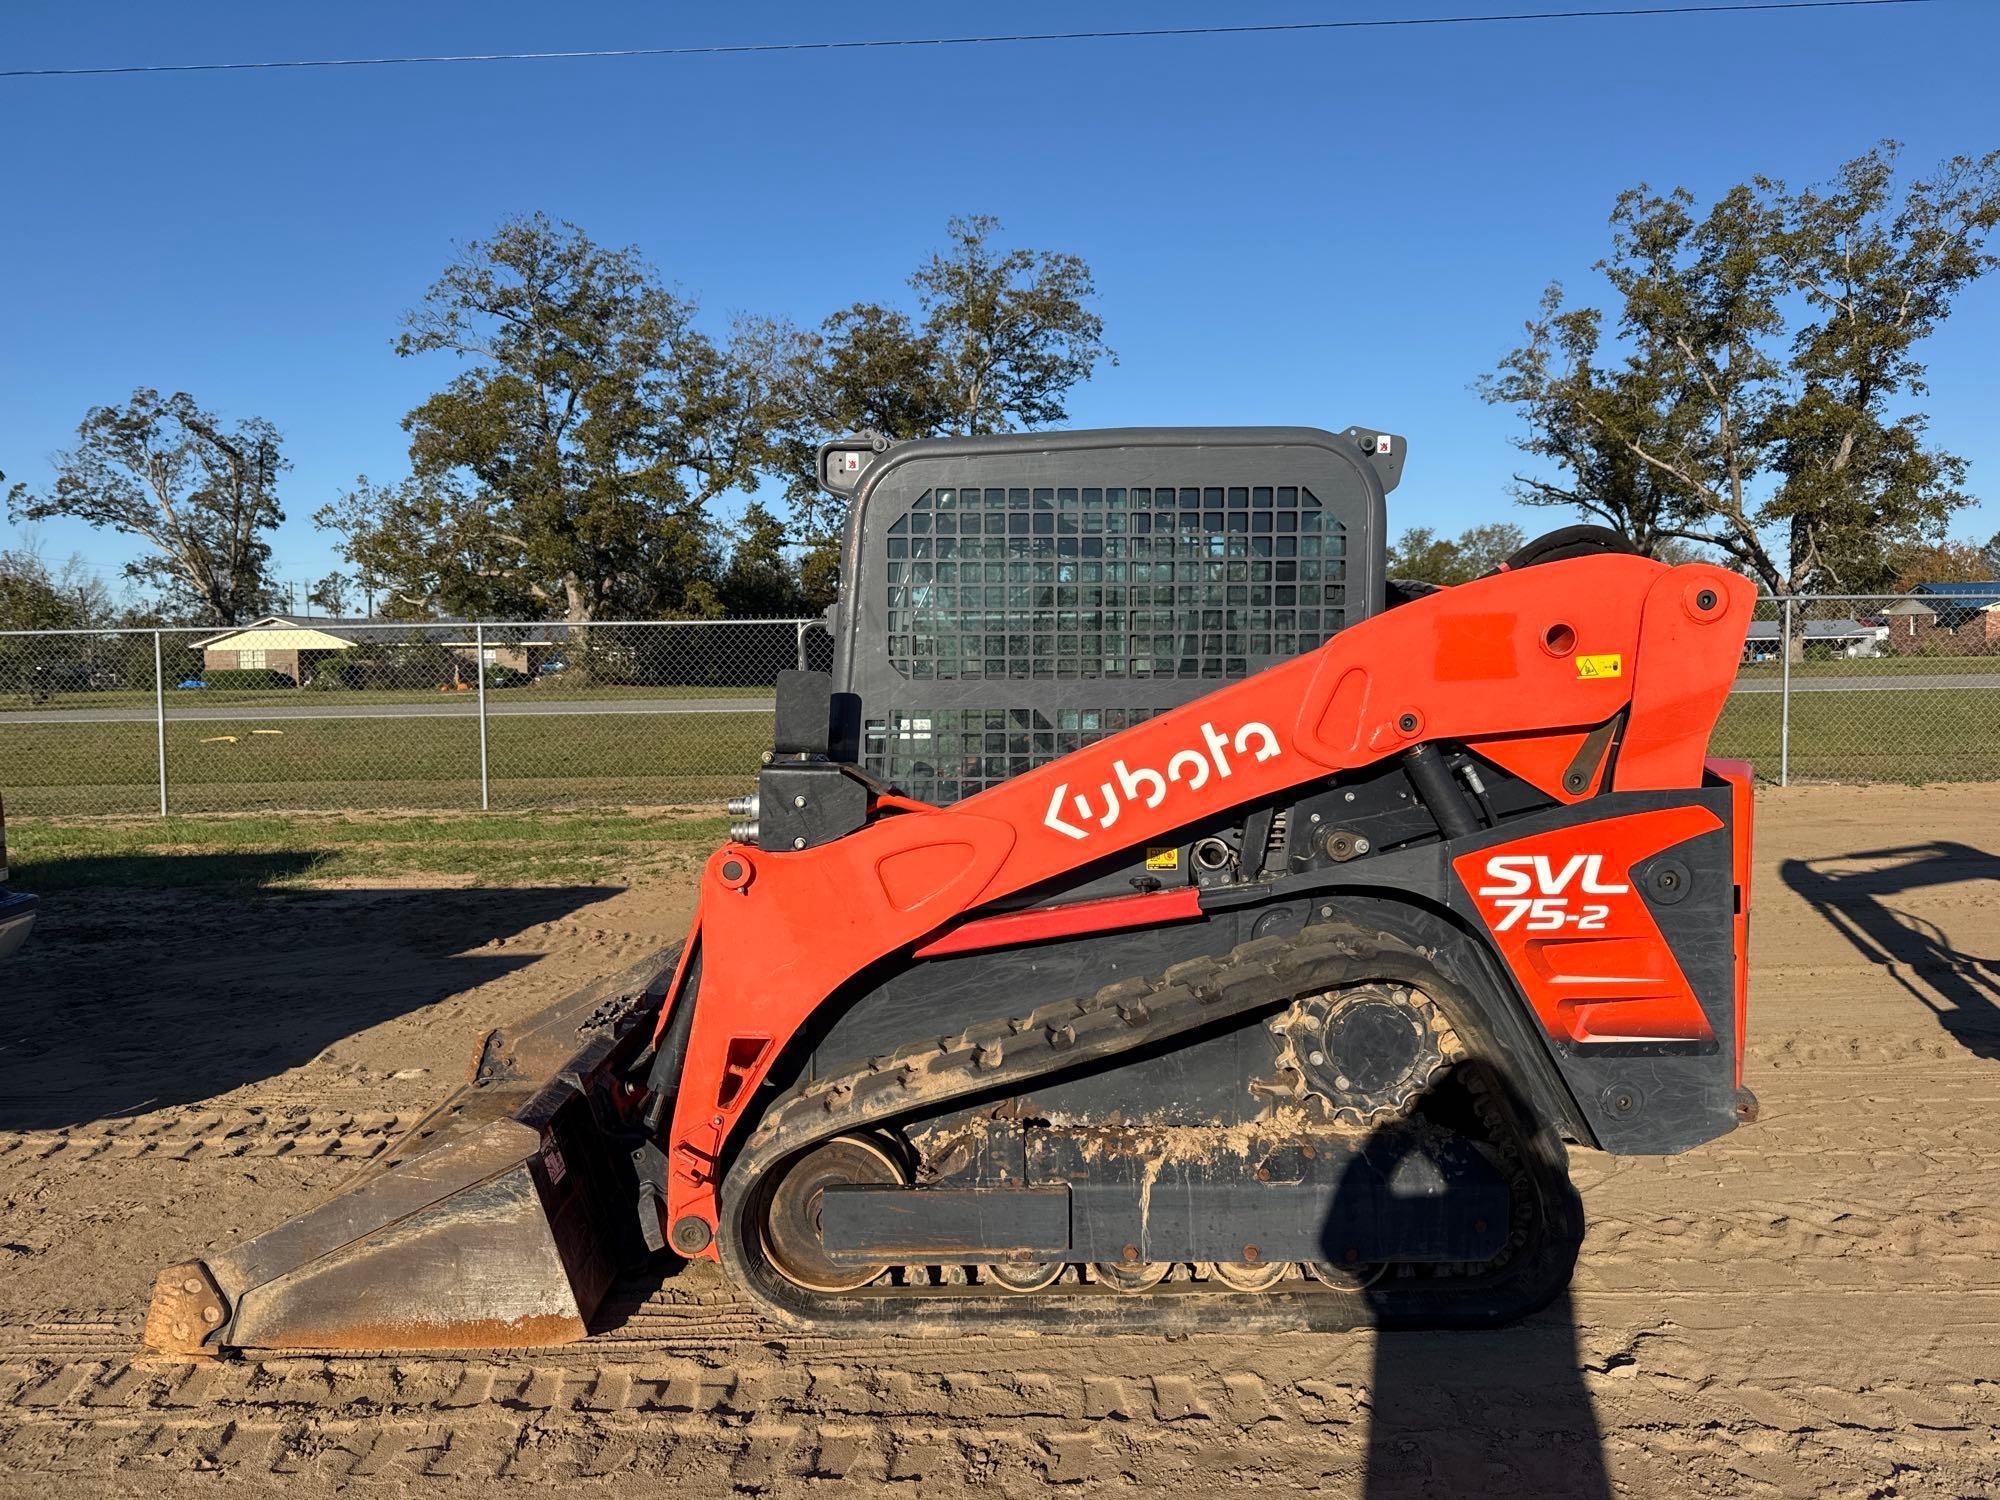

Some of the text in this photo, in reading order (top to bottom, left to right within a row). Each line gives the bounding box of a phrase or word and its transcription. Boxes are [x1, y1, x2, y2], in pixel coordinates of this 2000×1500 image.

[1044, 722, 1281, 839] Kubota
[1478, 854, 1629, 895] SVL
[1494, 898, 1609, 931] 75-2
